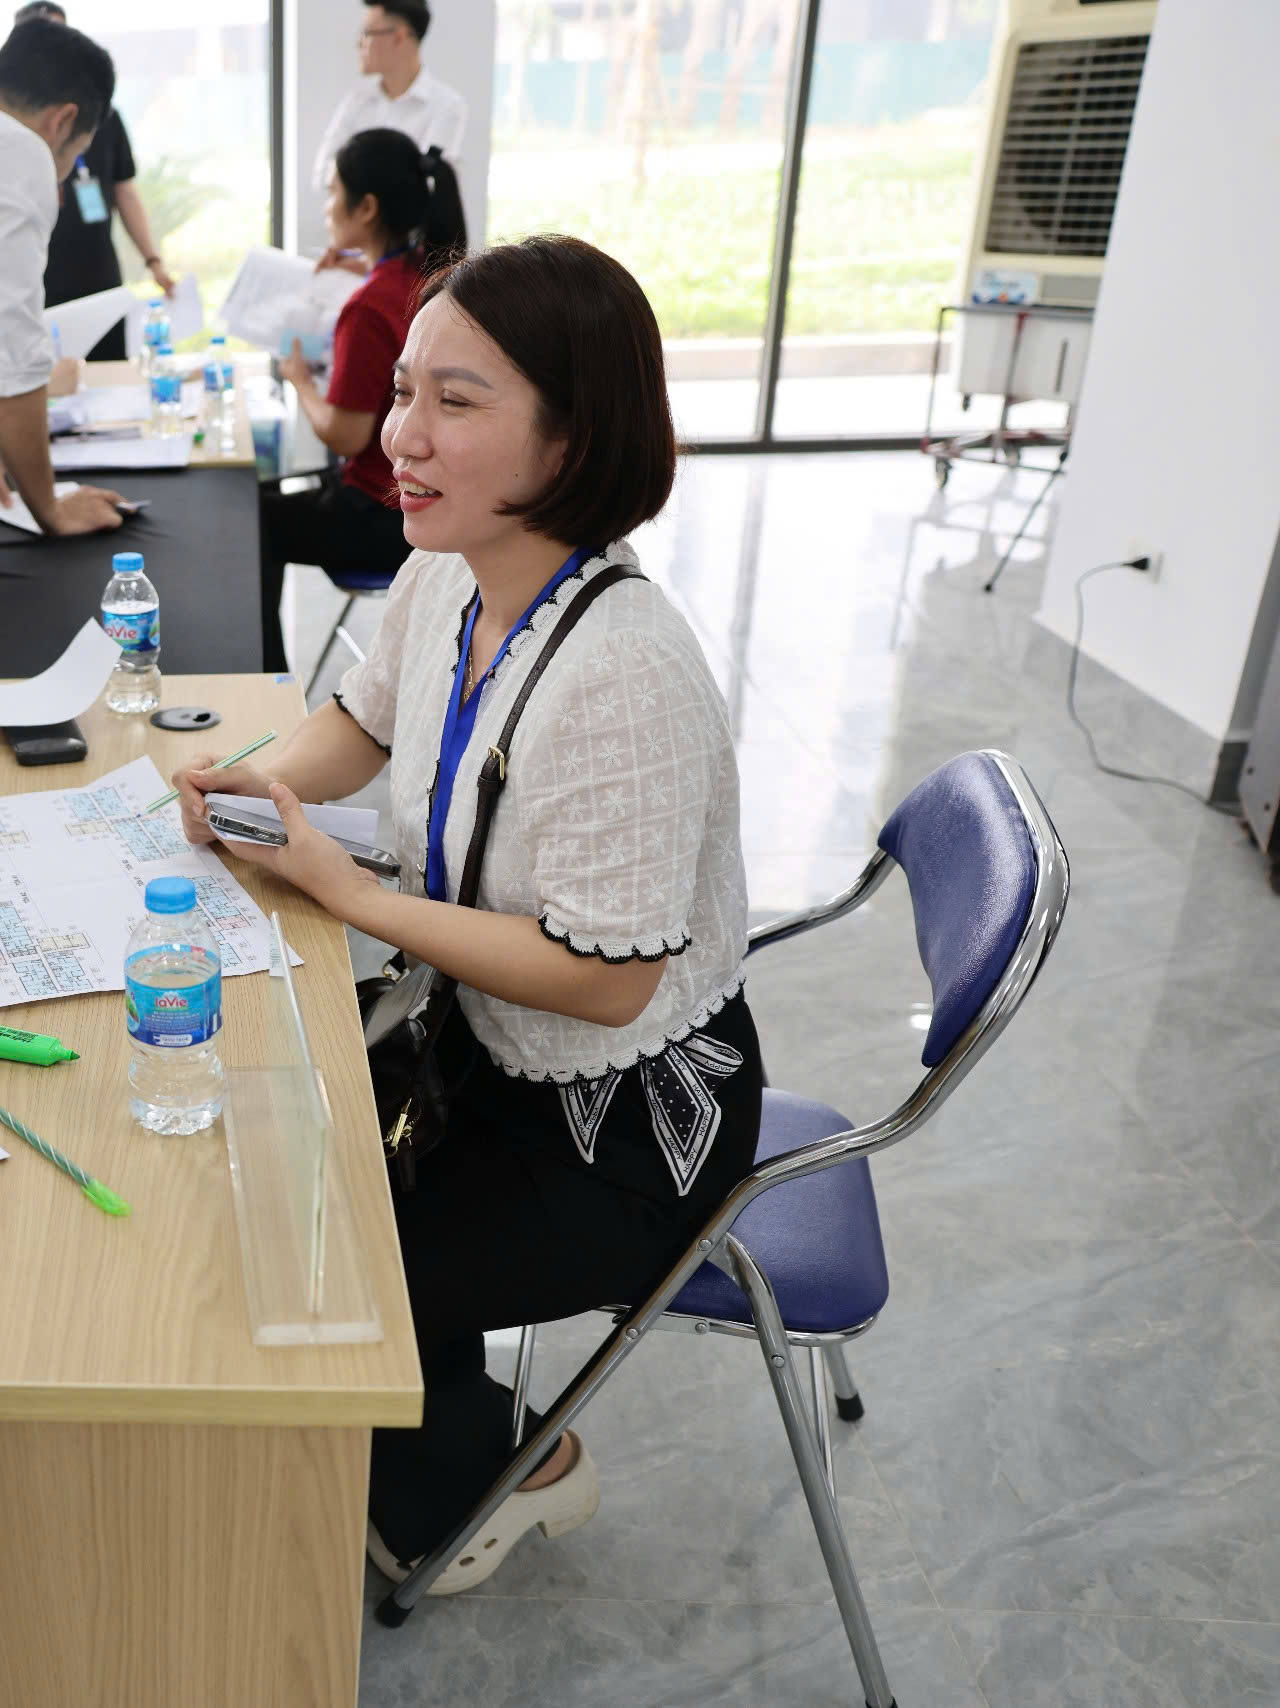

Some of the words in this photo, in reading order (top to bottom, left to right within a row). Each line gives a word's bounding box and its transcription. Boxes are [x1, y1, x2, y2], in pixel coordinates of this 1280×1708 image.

[104, 625, 137, 639] aVie
[704, 1060, 732, 1072] HAPPY
[692, 1083, 710, 1108] HAPPY
[699, 1110, 711, 1137] HAPPY
[667, 1137, 682, 1161] HAPPY
[683, 1148, 698, 1173] HAPPY
